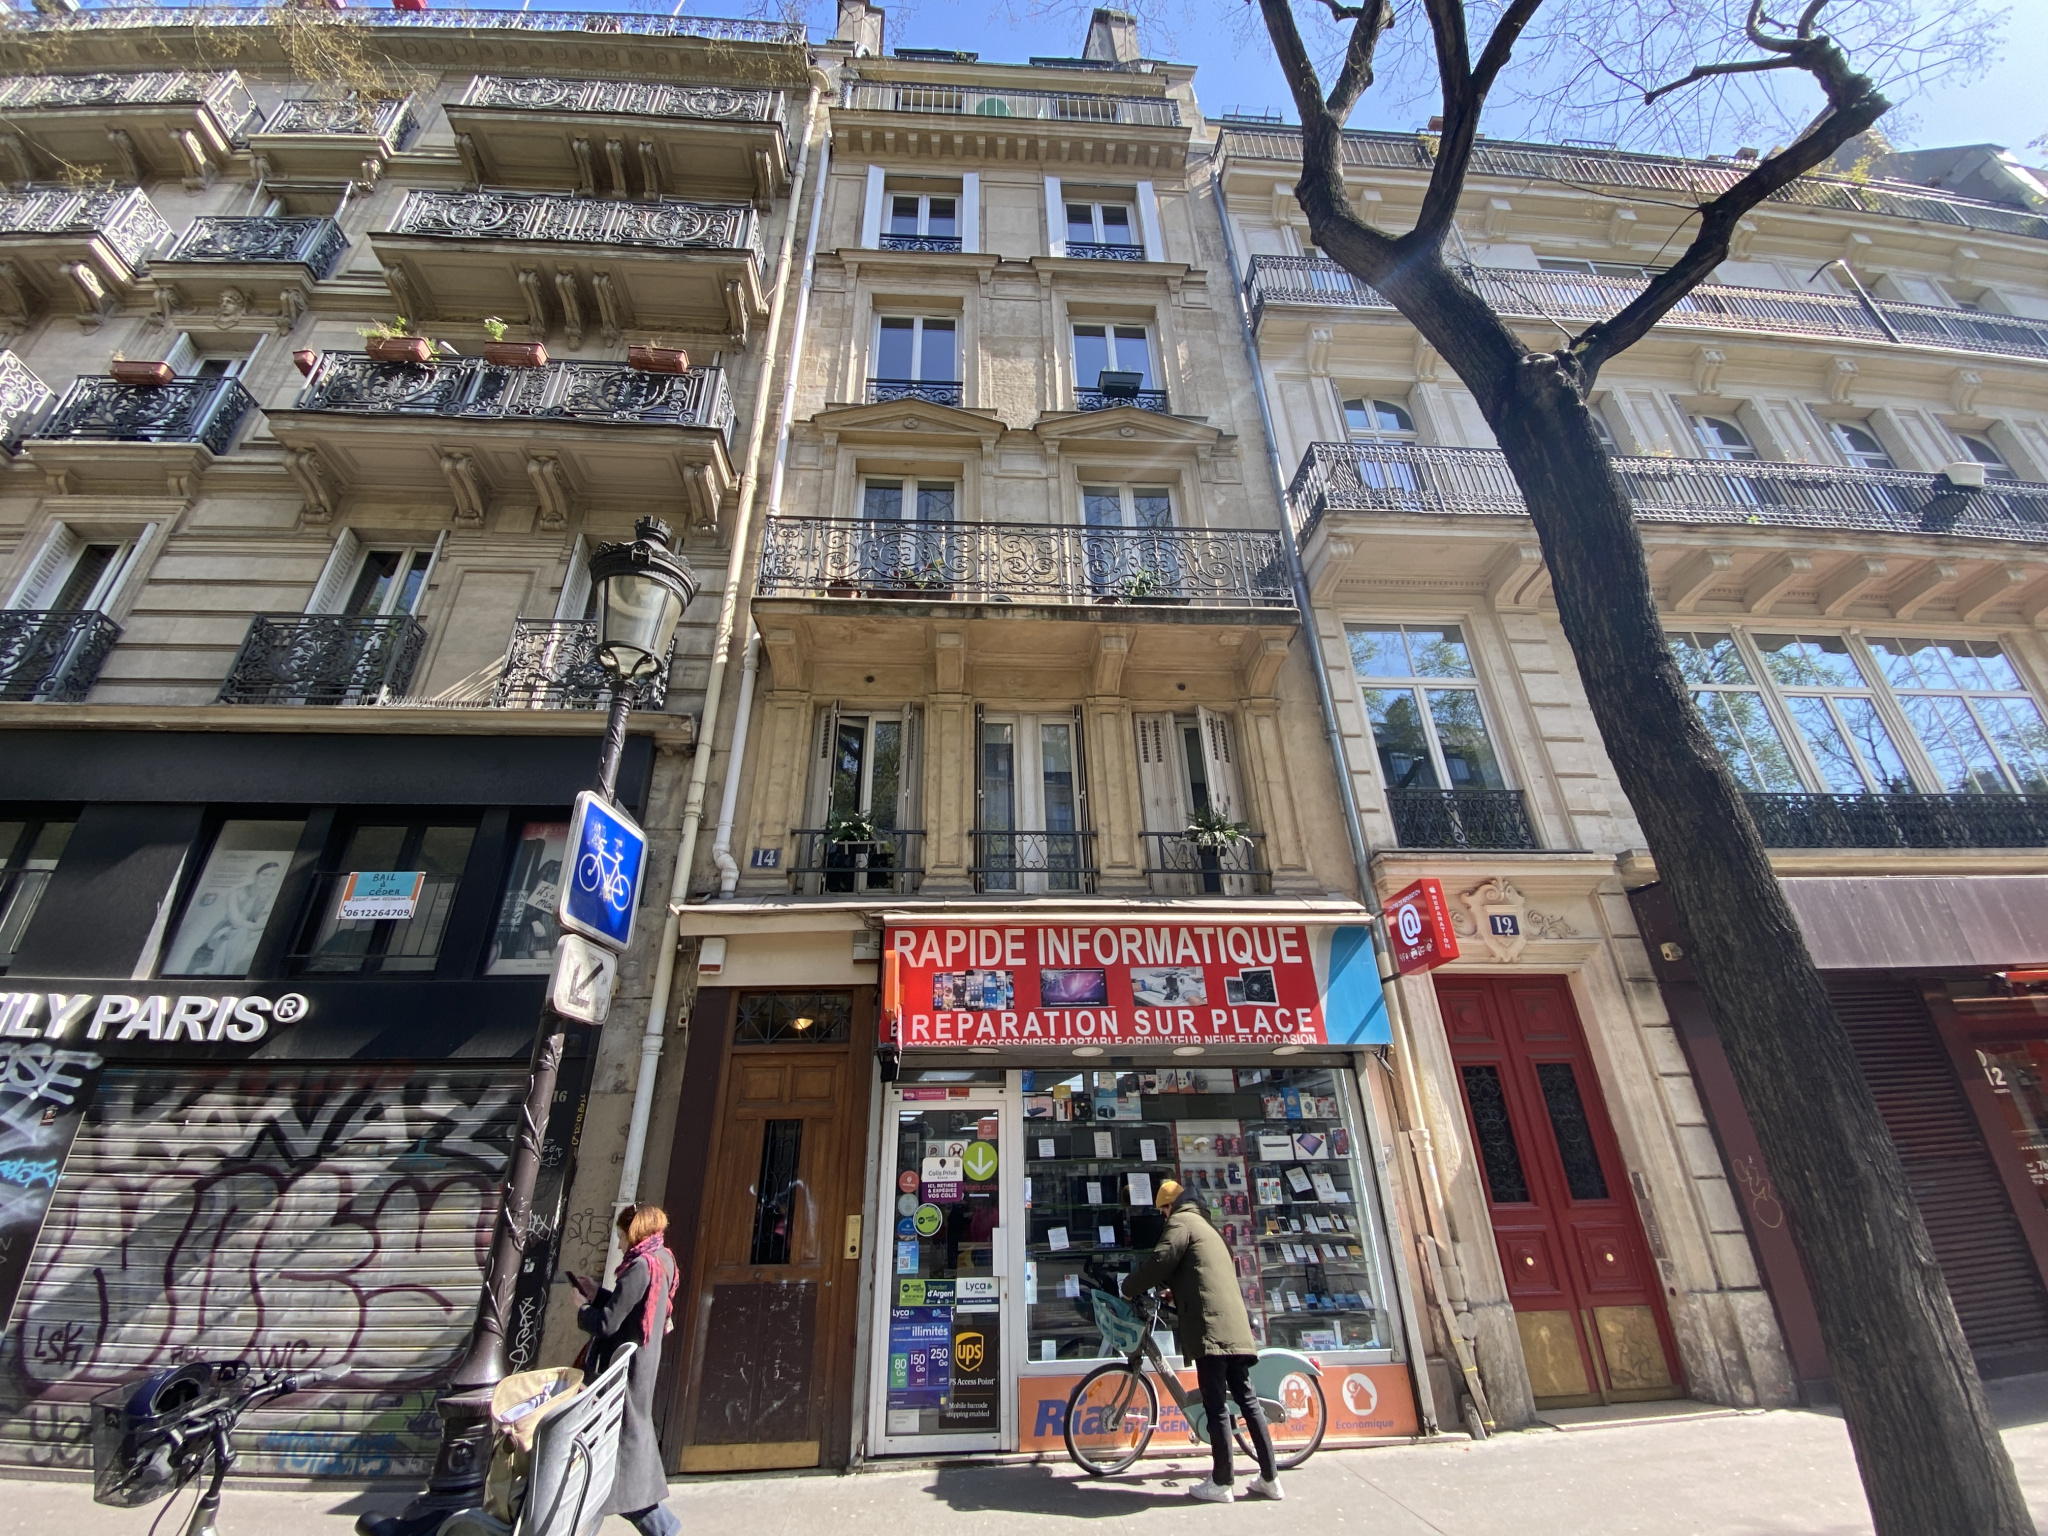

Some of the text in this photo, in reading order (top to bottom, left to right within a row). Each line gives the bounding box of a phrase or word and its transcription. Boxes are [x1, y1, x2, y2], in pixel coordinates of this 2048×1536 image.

[756, 849, 776, 866] 14
[346, 908, 410, 917] 0612264709
[1398, 903, 1422, 946] @
[1432, 895, 1450, 949] REPARATION
[1495, 916, 1514, 933] 12
[894, 926, 1303, 968] RAPIDE INFORMATIQUE
[912, 1008, 1316, 1040] REPARATION SUR PLACE
[552, 1090, 568, 1103] 16
[965, 1281, 986, 1291] Lyca
[927, 1289, 954, 1299] d'Argent
[892, 1309, 909, 1318] Lyca
[912, 1324, 948, 1336] illimités
[910, 1353, 925, 1364] 150
[930, 1348, 948, 1359] 250
[957, 1344, 982, 1365] ups
[895, 1358, 906, 1369] 80
[946, 1410, 968, 1418] shipping
[1335, 1418, 1395, 1431] Économique
